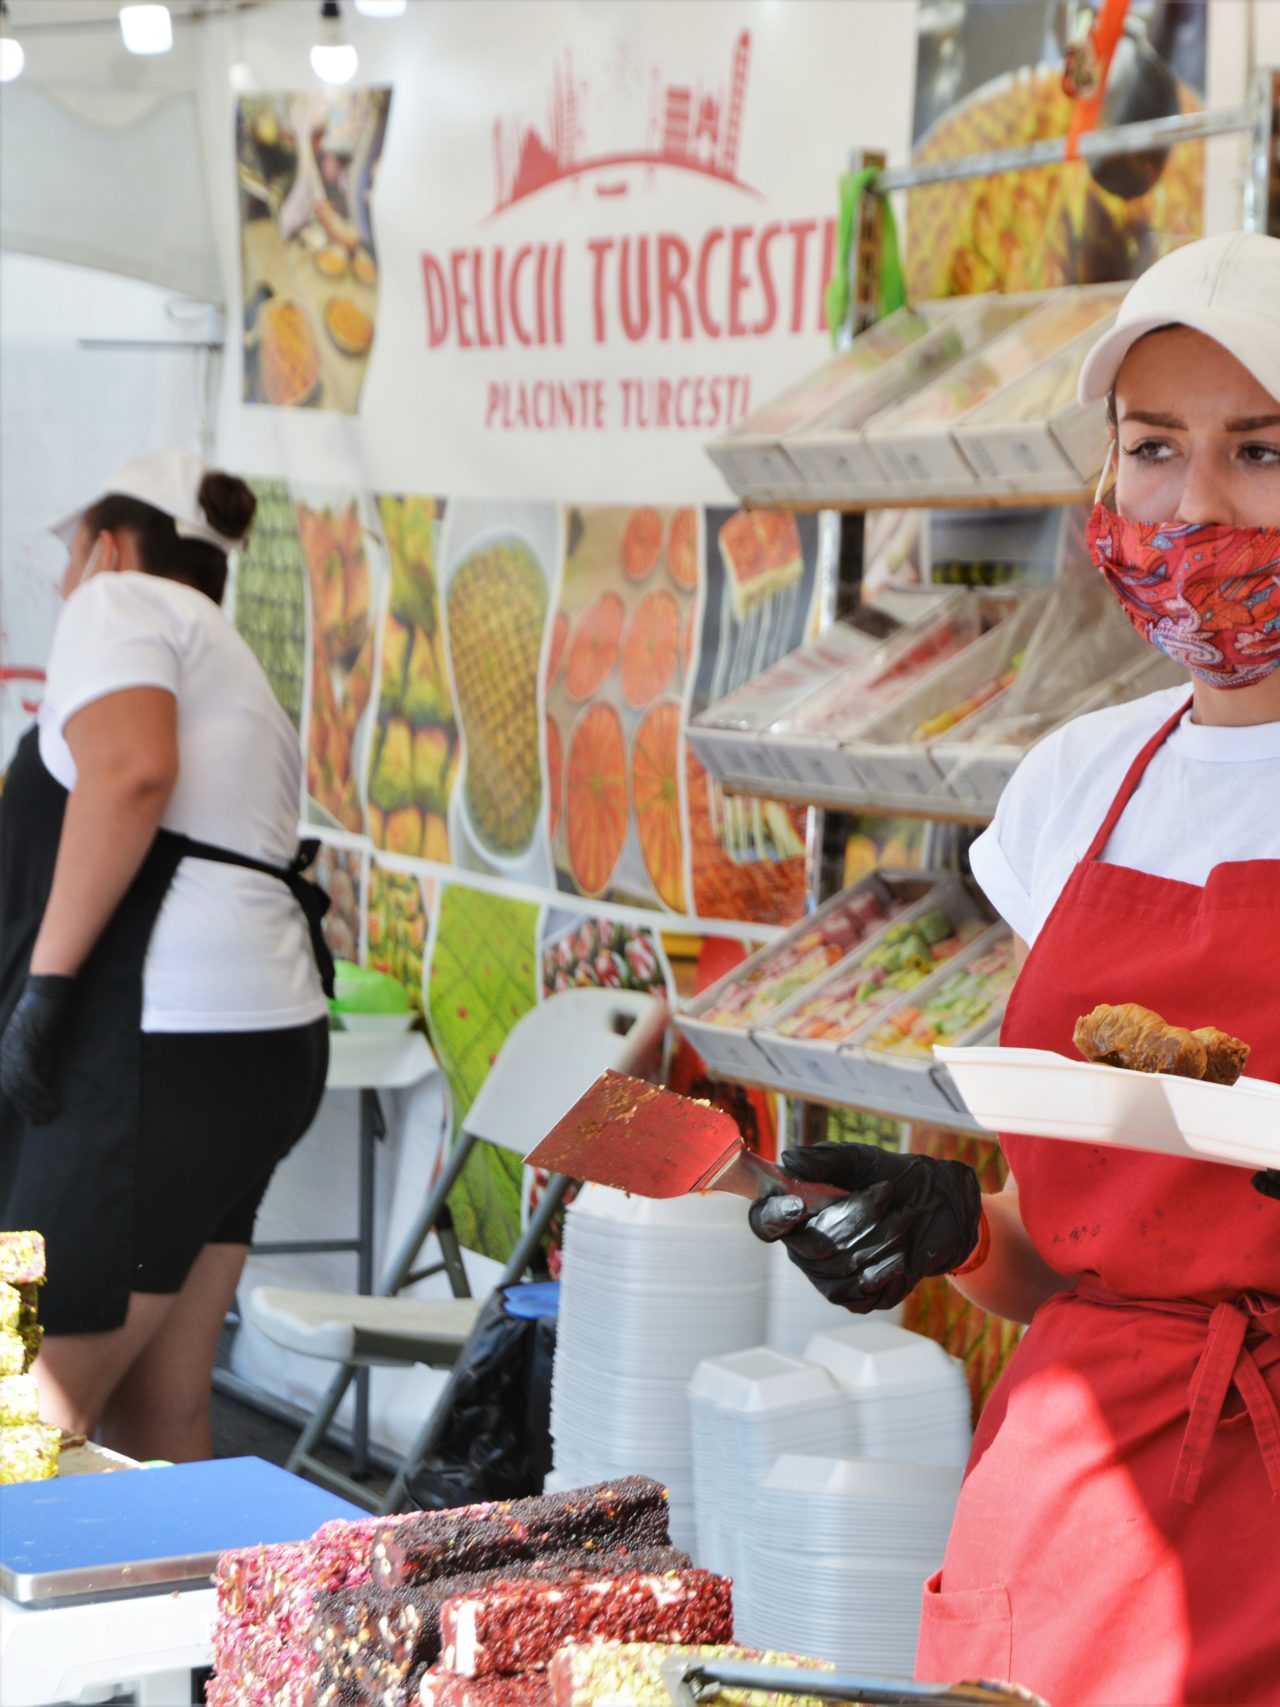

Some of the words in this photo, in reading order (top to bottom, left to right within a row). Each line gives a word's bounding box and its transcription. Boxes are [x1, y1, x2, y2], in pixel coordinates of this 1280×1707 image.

[421, 242, 565, 350] DELICII
[587, 216, 836, 344] TURCESTI
[484, 378, 605, 430] PLACINTE
[617, 373, 751, 430] TURCESTI
